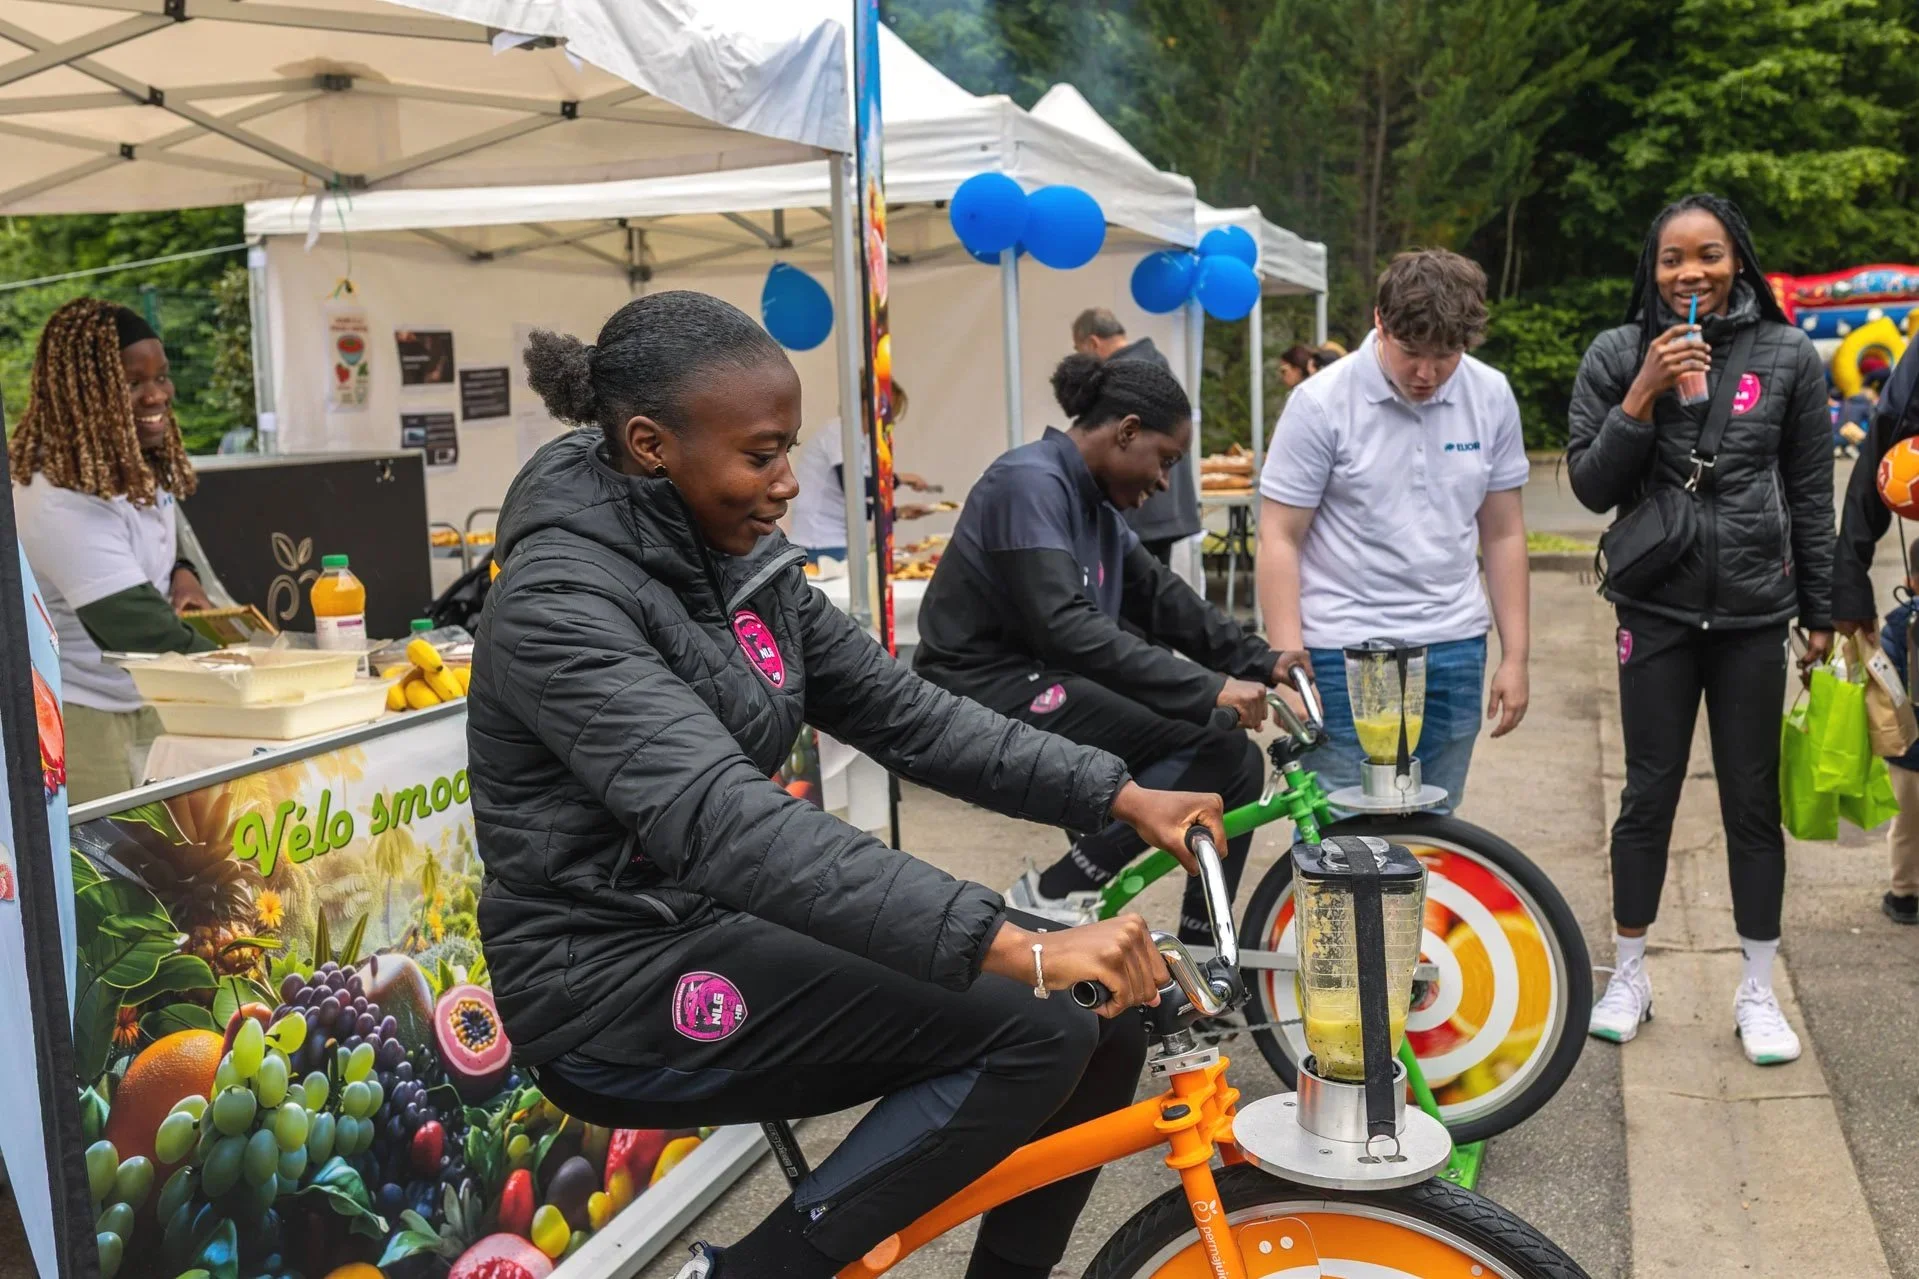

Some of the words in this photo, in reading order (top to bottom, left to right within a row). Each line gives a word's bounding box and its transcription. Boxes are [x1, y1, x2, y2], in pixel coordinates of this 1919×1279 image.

[232, 788, 354, 878] Vélo
[711, 992, 725, 1026] NLG
[734, 1004, 743, 1021] HB
